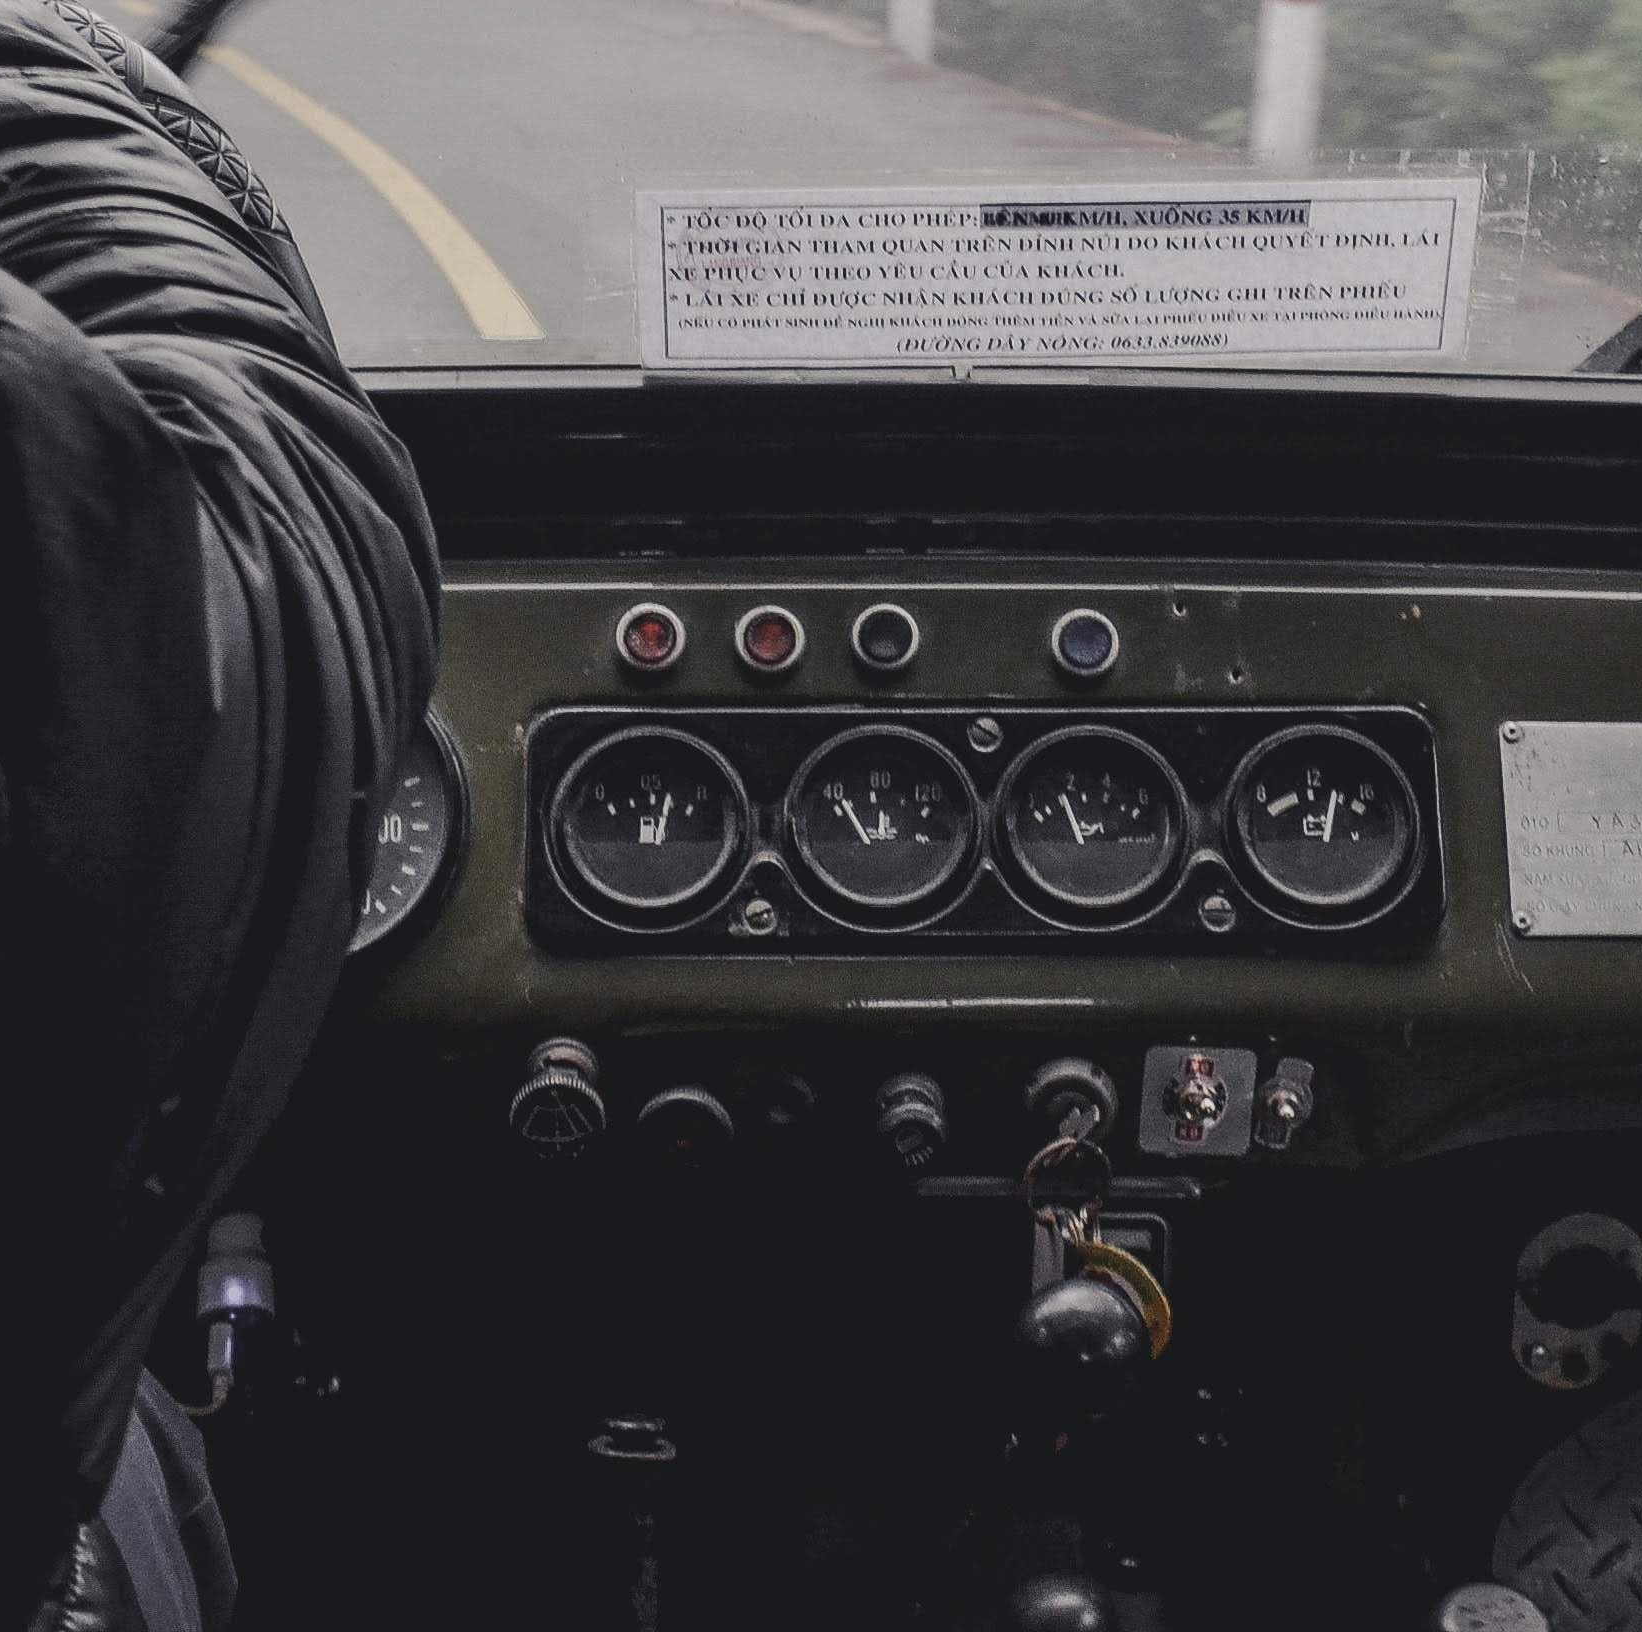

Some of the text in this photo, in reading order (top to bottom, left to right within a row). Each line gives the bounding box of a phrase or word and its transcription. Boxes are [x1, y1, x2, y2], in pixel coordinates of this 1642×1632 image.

[858, 212, 906, 229] CHO
[1217, 210, 1241, 226] 35
[1247, 208, 1306, 225] KM/H
[745, 239, 802, 255] GIAN
[808, 239, 875, 255] THAM
[882, 238, 945, 256] QUAN
[952, 234, 1012, 253] TRÊN
[1128, 236, 1158, 251] DO
[1166, 232, 1245, 251] KHÁCH
[669, 267, 696, 282] XE
[704, 267, 766, 284] PHỤC
[773, 267, 803, 283] VỤ
[810, 266, 872, 281] THEO
[879, 262, 923, 280] YÊU
[684, 288, 724, 307] LÁI
[730, 292, 759, 307] XE
[953, 288, 1034, 306] KHÁCH
[1227, 286, 1267, 302] GHI
[1273, 283, 1333, 301] TRÊN
[822, 781, 844, 801] 40
[914, 783, 943, 802] 120
